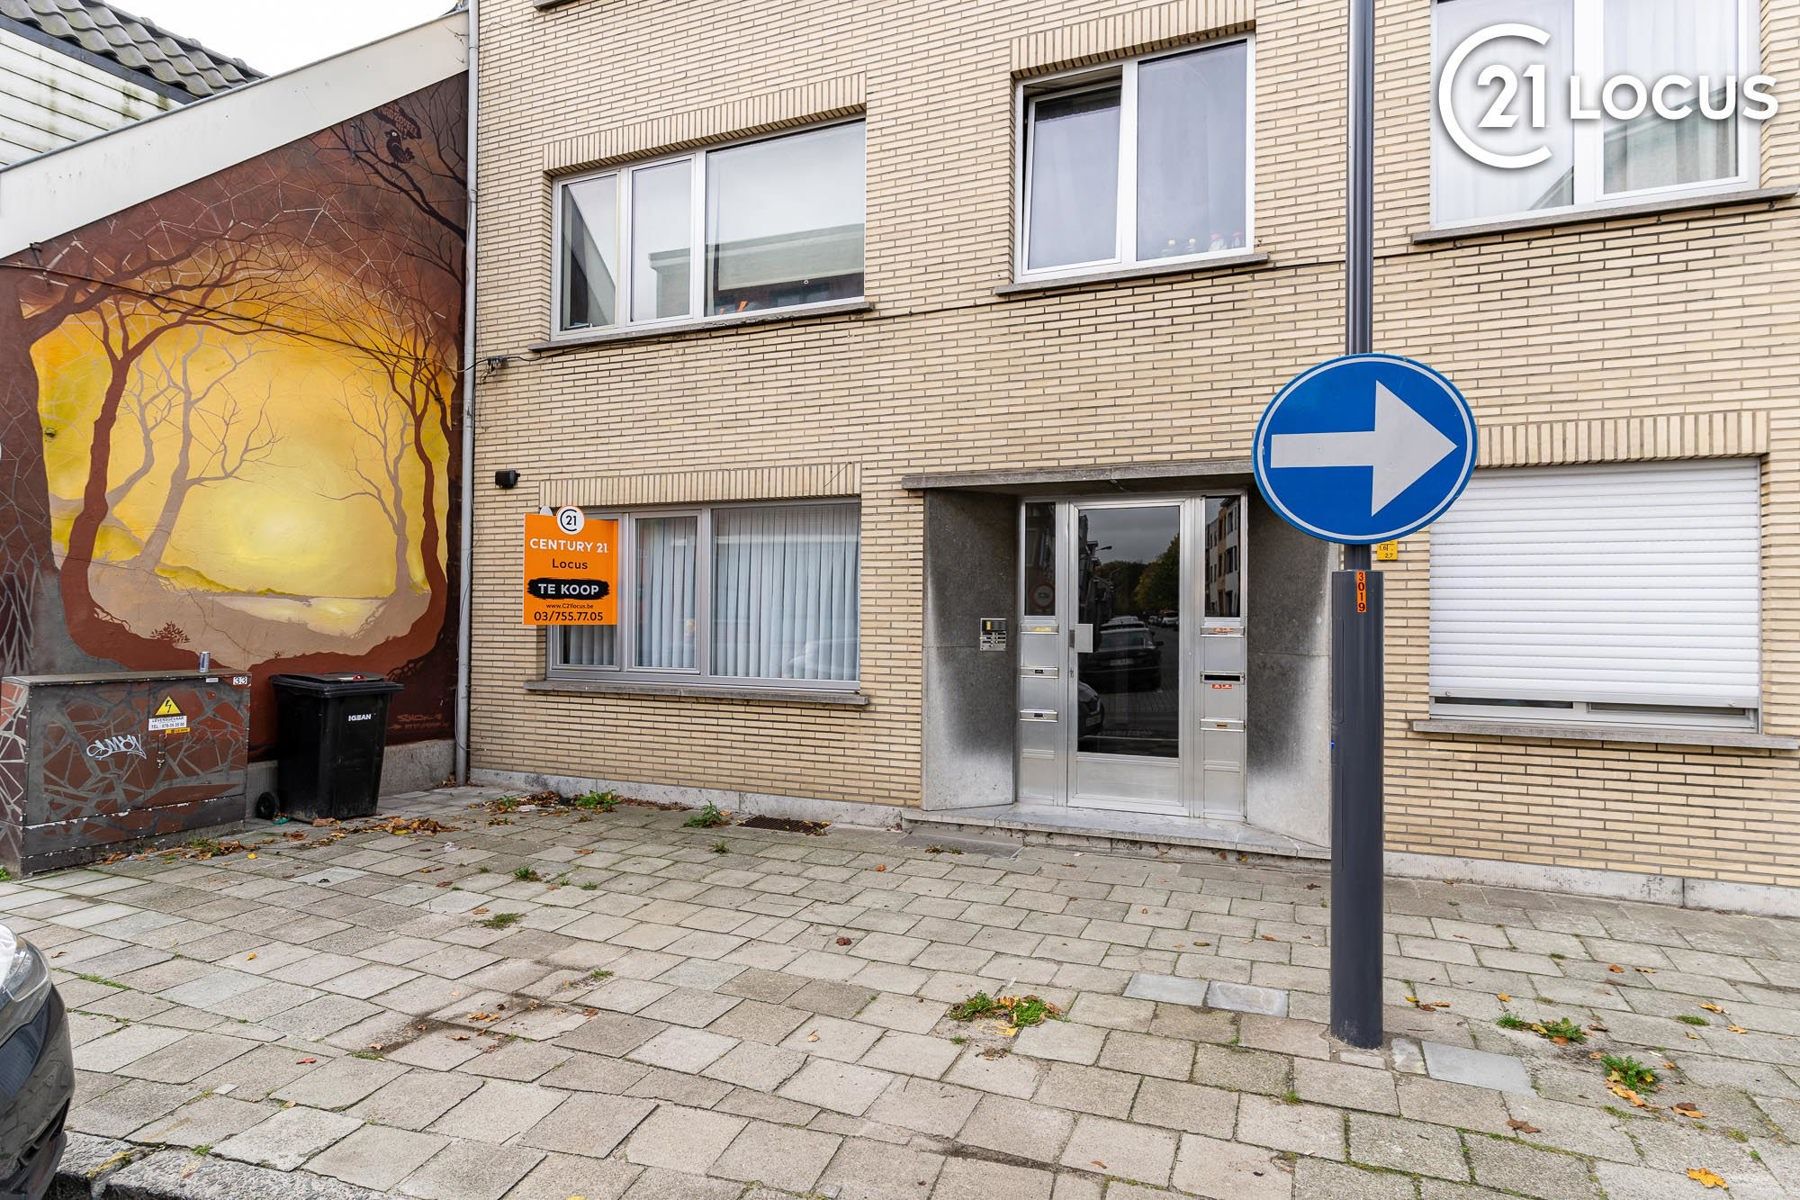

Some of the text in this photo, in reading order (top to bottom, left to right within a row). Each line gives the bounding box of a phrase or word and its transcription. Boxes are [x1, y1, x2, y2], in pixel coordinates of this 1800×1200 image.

[530, 538, 608, 554] CENTURY 21
[552, 558, 588, 570] Locus
[538, 584, 599, 595] TE KOOP
[1358, 571, 1366, 612] 3019
[534, 611, 604, 622] 03/755.77.05
